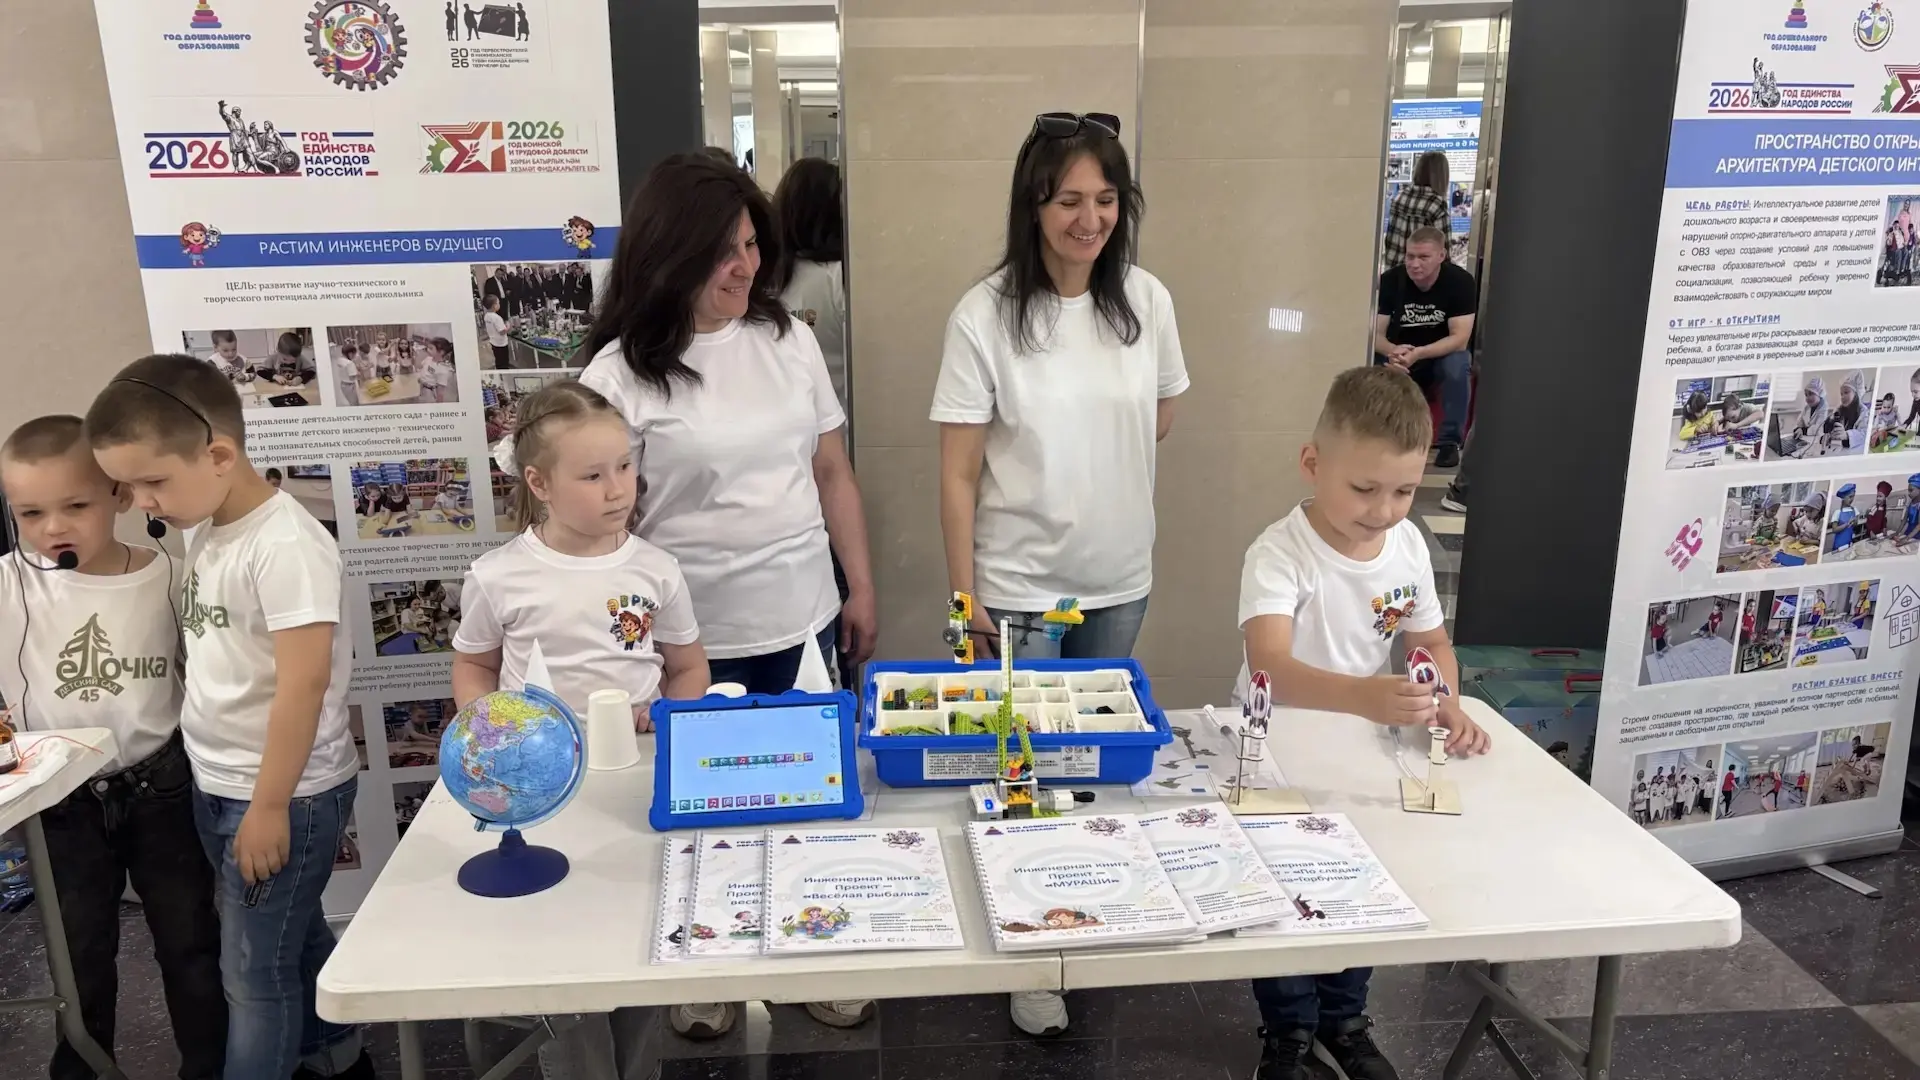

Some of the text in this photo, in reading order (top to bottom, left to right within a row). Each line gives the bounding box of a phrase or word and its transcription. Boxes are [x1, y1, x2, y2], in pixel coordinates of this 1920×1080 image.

[1763, 33, 1827, 42] ГОД ДОШКОЛЬНОГО
[450, 48, 468, 57] 20
[452, 59, 469, 68] 26
[1709, 88, 1750, 107] 2026
[1782, 89, 1841, 98] ГОД ЕДИНСТВА
[1781, 100, 1852, 108] НАРОДОВ РОССИИ
[507, 121, 564, 139] 2026
[301, 132, 329, 143] ГОД
[1755, 134, 1871, 149] ПРОСТРАНСТВО
[303, 143, 375, 154] ЕДИНСТВА
[146, 140, 229, 170] 2026
[305, 156, 370, 167] НАРОДОВ
[1716, 158, 1816, 174] АРХИТЕКТУРА
[1819, 157, 1894, 174] ДЕТСКОГО
[306, 167, 363, 176] РОССИИ
[1686, 199, 1880, 210] ЦЕЛЬ РАБОТЫ: Интеллектуальное развитие детей
[1683, 214, 1878, 227] дошкольного возраста своевременная коррекция
[1682, 228, 1876, 242] нарушений опорно-двигательного аппарата детей
[259, 237, 503, 254] РАСТИМ ИНЖЕНЕРОВ БУДУЩЕГО
[1691, 247, 1710, 256] ОВЗ
[1715, 247, 1735, 256] через
[1740, 246, 1773, 254] создание
[1778, 244, 1809, 254] условий
[1832, 244, 1874, 252] повышения
[1678, 258, 1872, 272] качества образовательной среды успешной
[1741, 275, 1792, 284] позволяющей
[1800, 274, 1829, 283] ребенку
[1836, 273, 1869, 281] уверенно
[226, 279, 398, 291] ЦЕЛЬ: развитие научно-технического
[204, 290, 424, 304] творческого потенциала личности дошкольника
[1674, 288, 1832, 303] взаимодействовать окружающим миром
[1669, 314, 1780, 328] ОТ ИГР ОТКРЫТИЯМ
[1668, 334, 1694, 343] Через
[1696, 332, 1750, 342] увлекательные
[1751, 331, 1769, 340] игры
[1771, 328, 1816, 340] раскрываем
[1802, 339, 1824, 348] среда
[1665, 355, 1715, 366] превращают
[301, 414, 362, 425] деятельности
[364, 412, 402, 422] детского
[429, 411, 459, 420] раннее
[258, 428, 300, 439] развитие
[301, 427, 340, 438] детского
[342, 426, 390, 435] инженерно
[398, 423, 455, 433] технического
[268, 435, 462, 452] познавательных способностей детей, ранняя
[326, 447, 427, 461] старших дошкольников
[402, 543, 449, 551] творчество
[364, 556, 409, 566] родителей
[411, 556, 437, 565] лучше
[396, 566, 440, 575] открывать
[1792, 670, 1903, 692] РАСТИМ БУДУЩЕЕ ВМЕСТЕ
[60, 679, 118, 697] ДЕТСКИЙ САД
[79, 689, 100, 702] 45
[1188, 843, 1221, 852] книга
[1014, 861, 1129, 873] Инженерная книга
[1048, 871, 1092, 880] Проект
[1045, 878, 1120, 888] «МУРАШИ»
